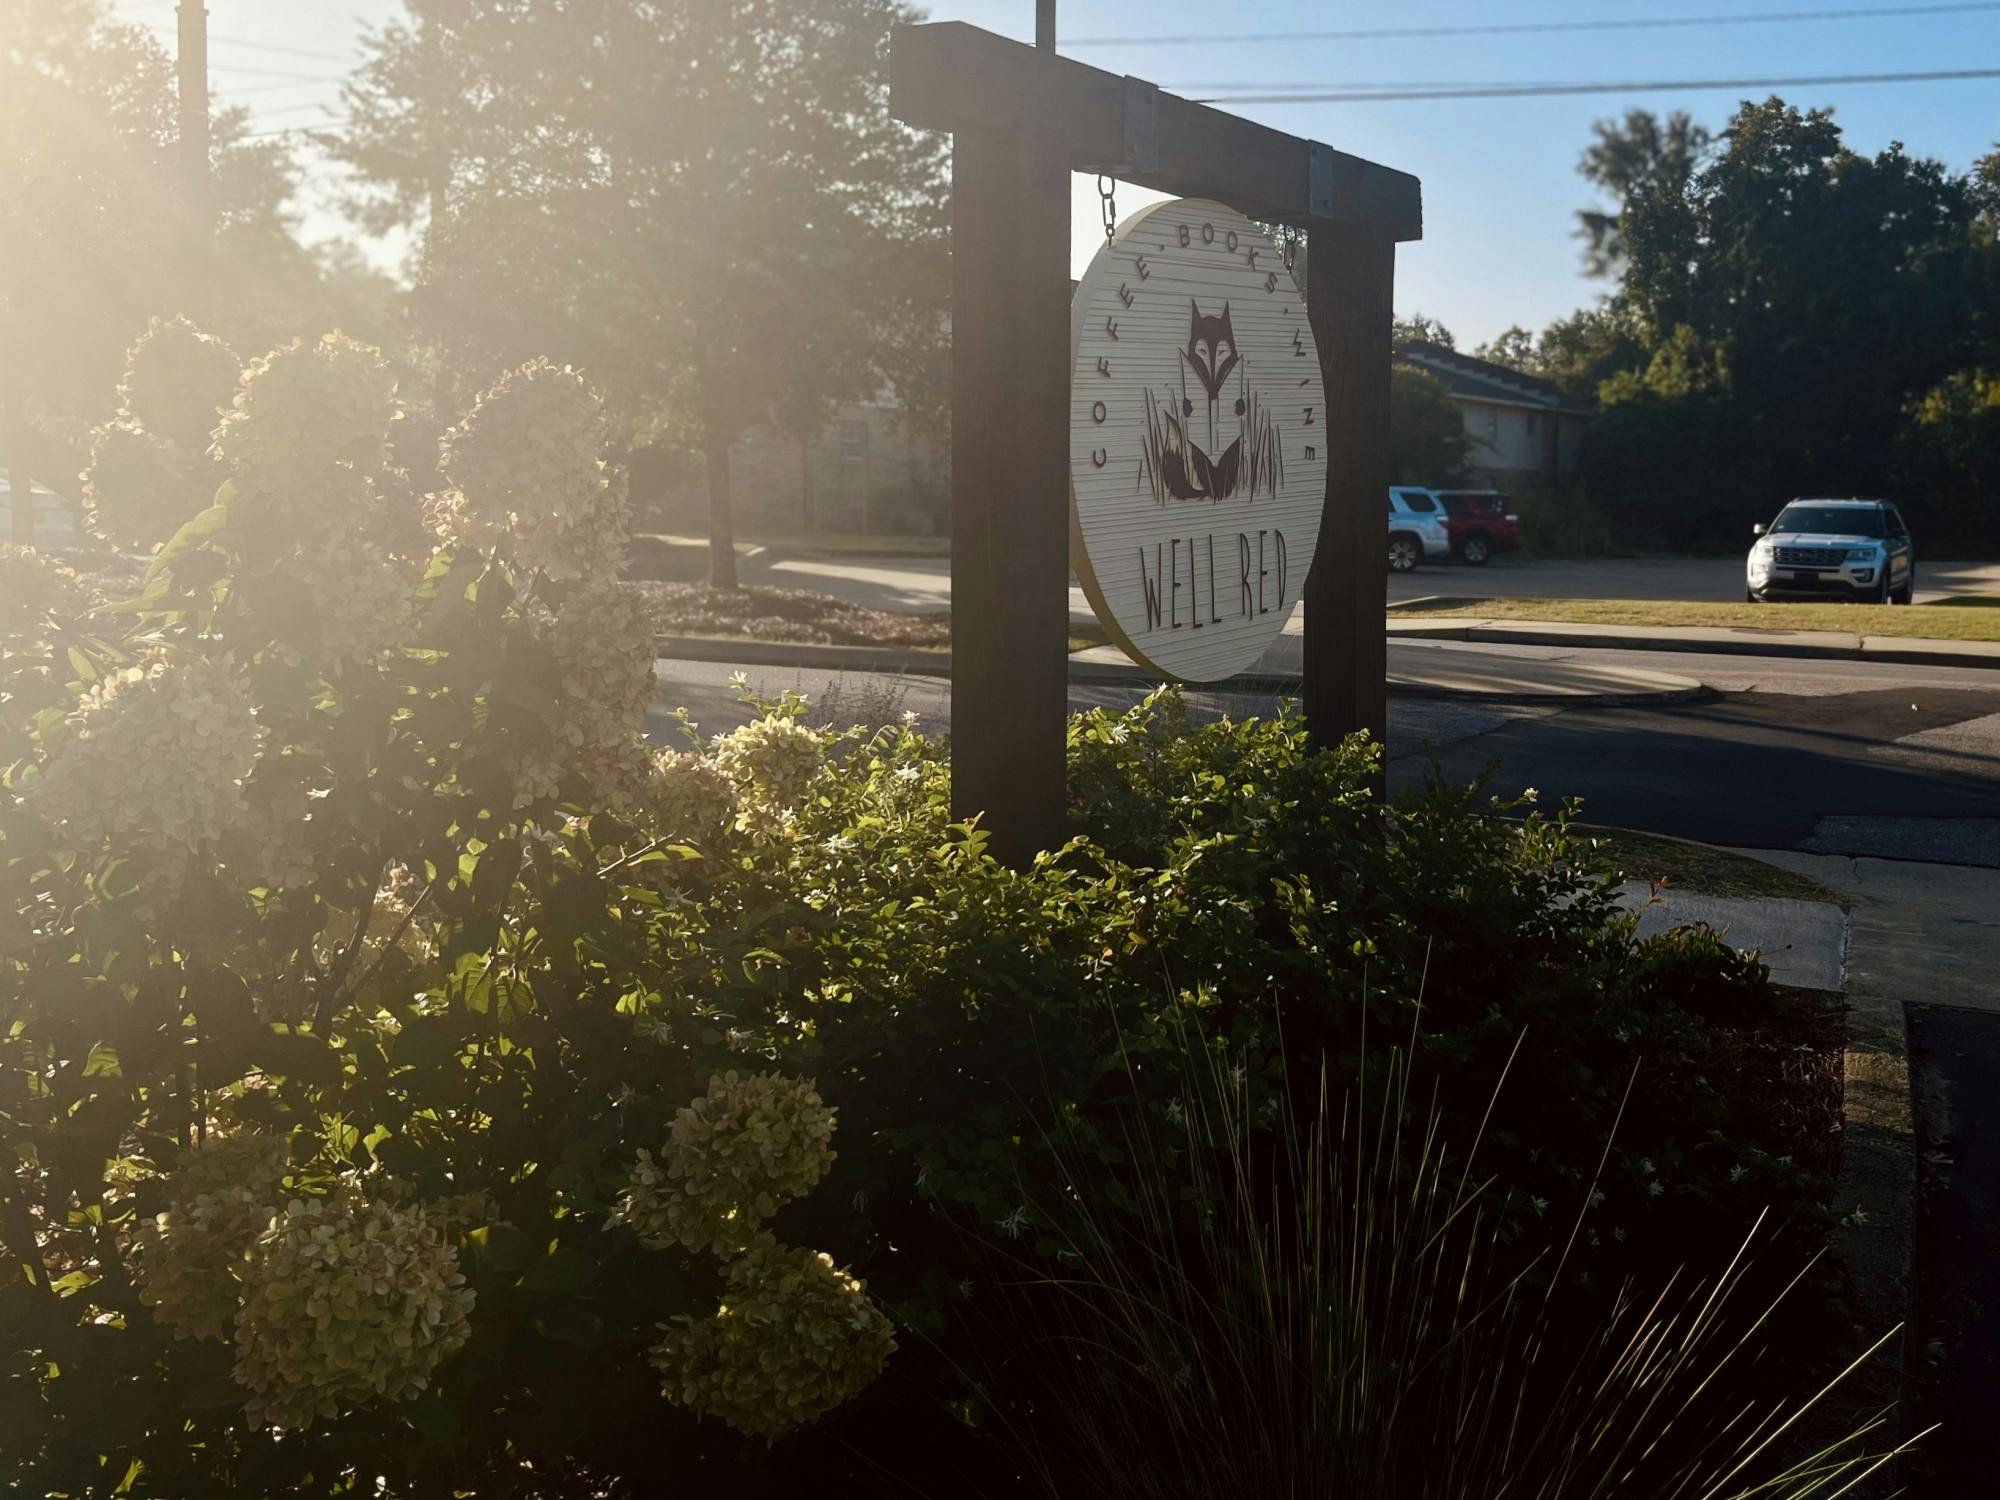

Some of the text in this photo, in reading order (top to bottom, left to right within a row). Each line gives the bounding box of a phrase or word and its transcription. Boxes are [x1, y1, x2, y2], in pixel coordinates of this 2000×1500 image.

[1092, 222, 1316, 468] COFFEE BOOKS WINE
[1140, 529, 1287, 632] WELL RED
